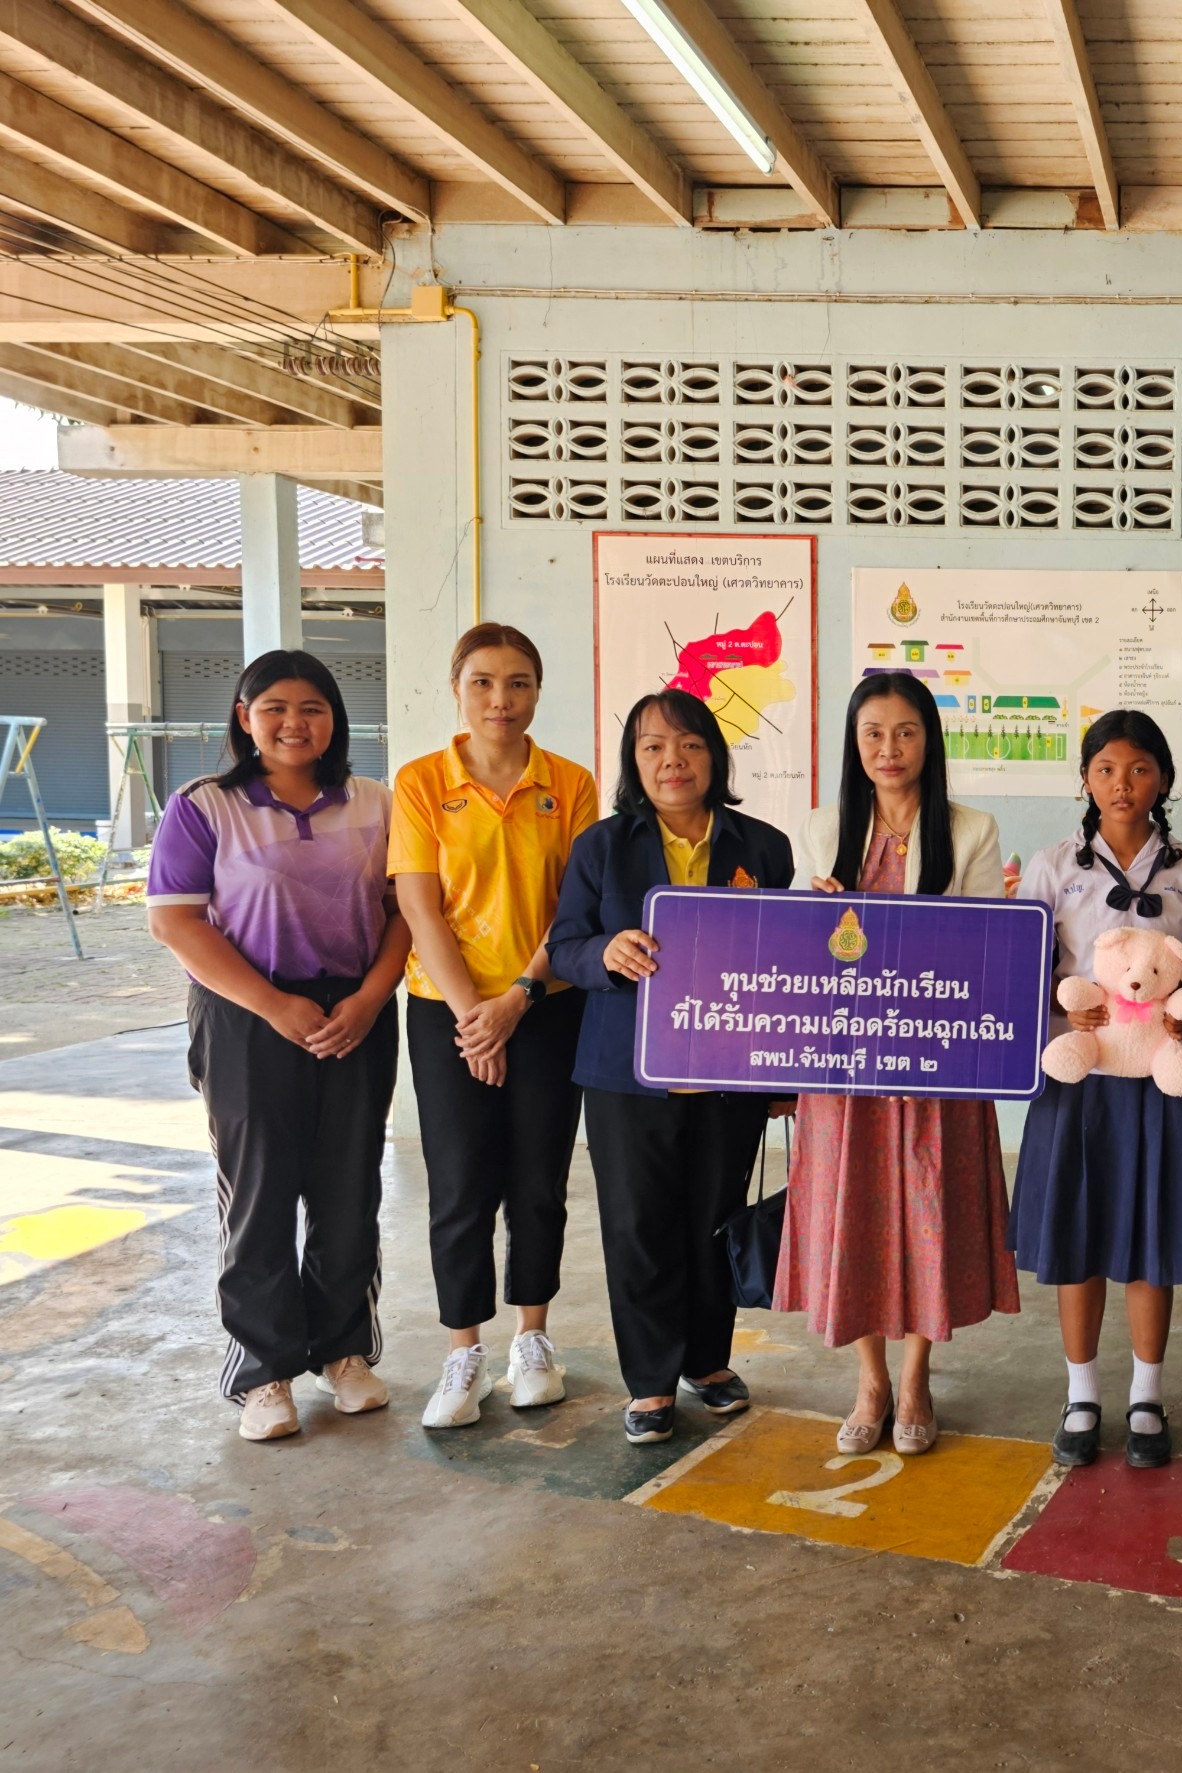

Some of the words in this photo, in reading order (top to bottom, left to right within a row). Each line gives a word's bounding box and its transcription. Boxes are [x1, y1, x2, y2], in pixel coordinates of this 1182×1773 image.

[646, 550, 704, 565] แผนที่แสดง
[711, 553, 763, 566] เขตบริการ
[604, 573, 719, 591] โรงเรียนวัดตะปอนใหญ่
[720, 965, 970, 1001] ทุนช่วยเหลือนักเรียน
[670, 996, 1015, 1048] ที่ได้รับความเดือดร้อนฉุกเฉิน
[749, 1046, 867, 1077] สพป.จันทบุรี
[876, 1052, 911, 1072] เขต
[919, 1056, 938, 1072] ๒
[765, 1452, 905, 1518] 2
